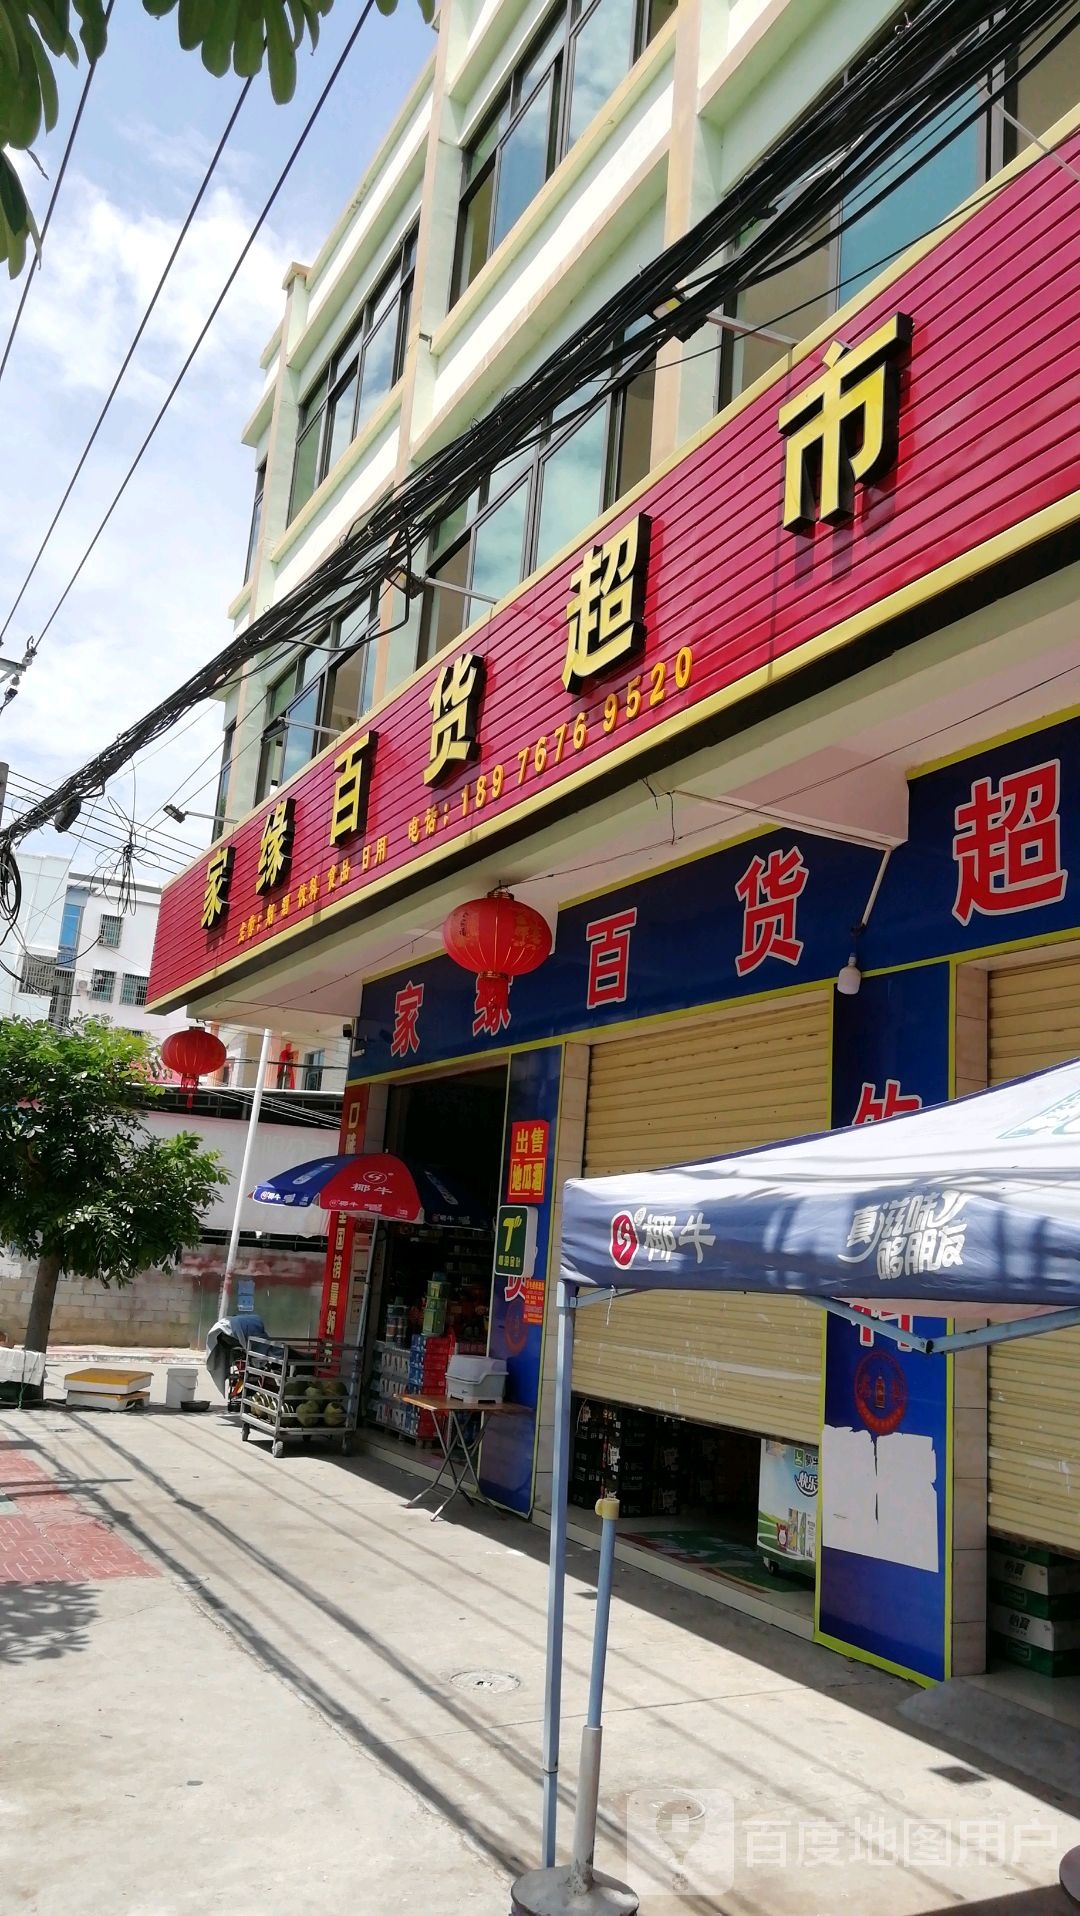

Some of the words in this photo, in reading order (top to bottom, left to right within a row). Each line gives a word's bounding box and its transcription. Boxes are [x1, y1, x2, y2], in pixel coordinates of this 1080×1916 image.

[200, 313, 910, 928] 家缘百货超市
[461, 764, 504, 818] 189
[517, 710, 589, 781] 7676
[603, 645, 693, 733] 9520
[362, 835, 388, 871] 日用
[515, 1126, 545, 1153] 出售
[351, 1182, 393, 1196] 椰牛
[642, 1211, 717, 1265] 椰牛
[837, 1190, 976, 1263] 真滋味
